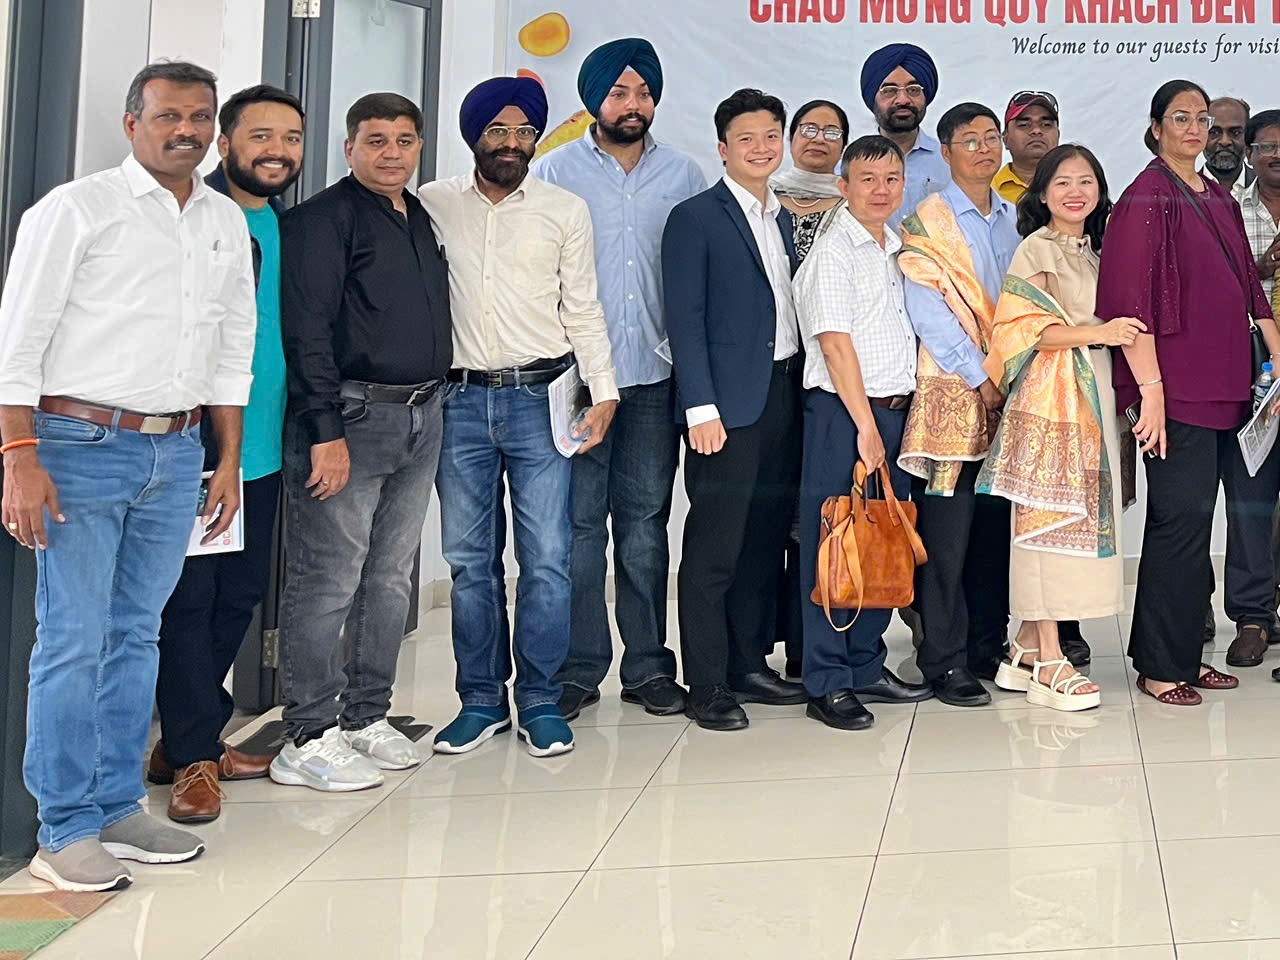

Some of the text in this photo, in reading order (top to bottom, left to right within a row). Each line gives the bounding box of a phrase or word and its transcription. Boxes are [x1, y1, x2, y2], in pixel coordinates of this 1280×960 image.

[1012, 33, 1086, 55] Welcome
[1093, 39, 1110, 55] to
[1115, 41, 1147, 55] our
[1149, 37, 1208, 63] guests
[1209, 32, 1243, 63] for
